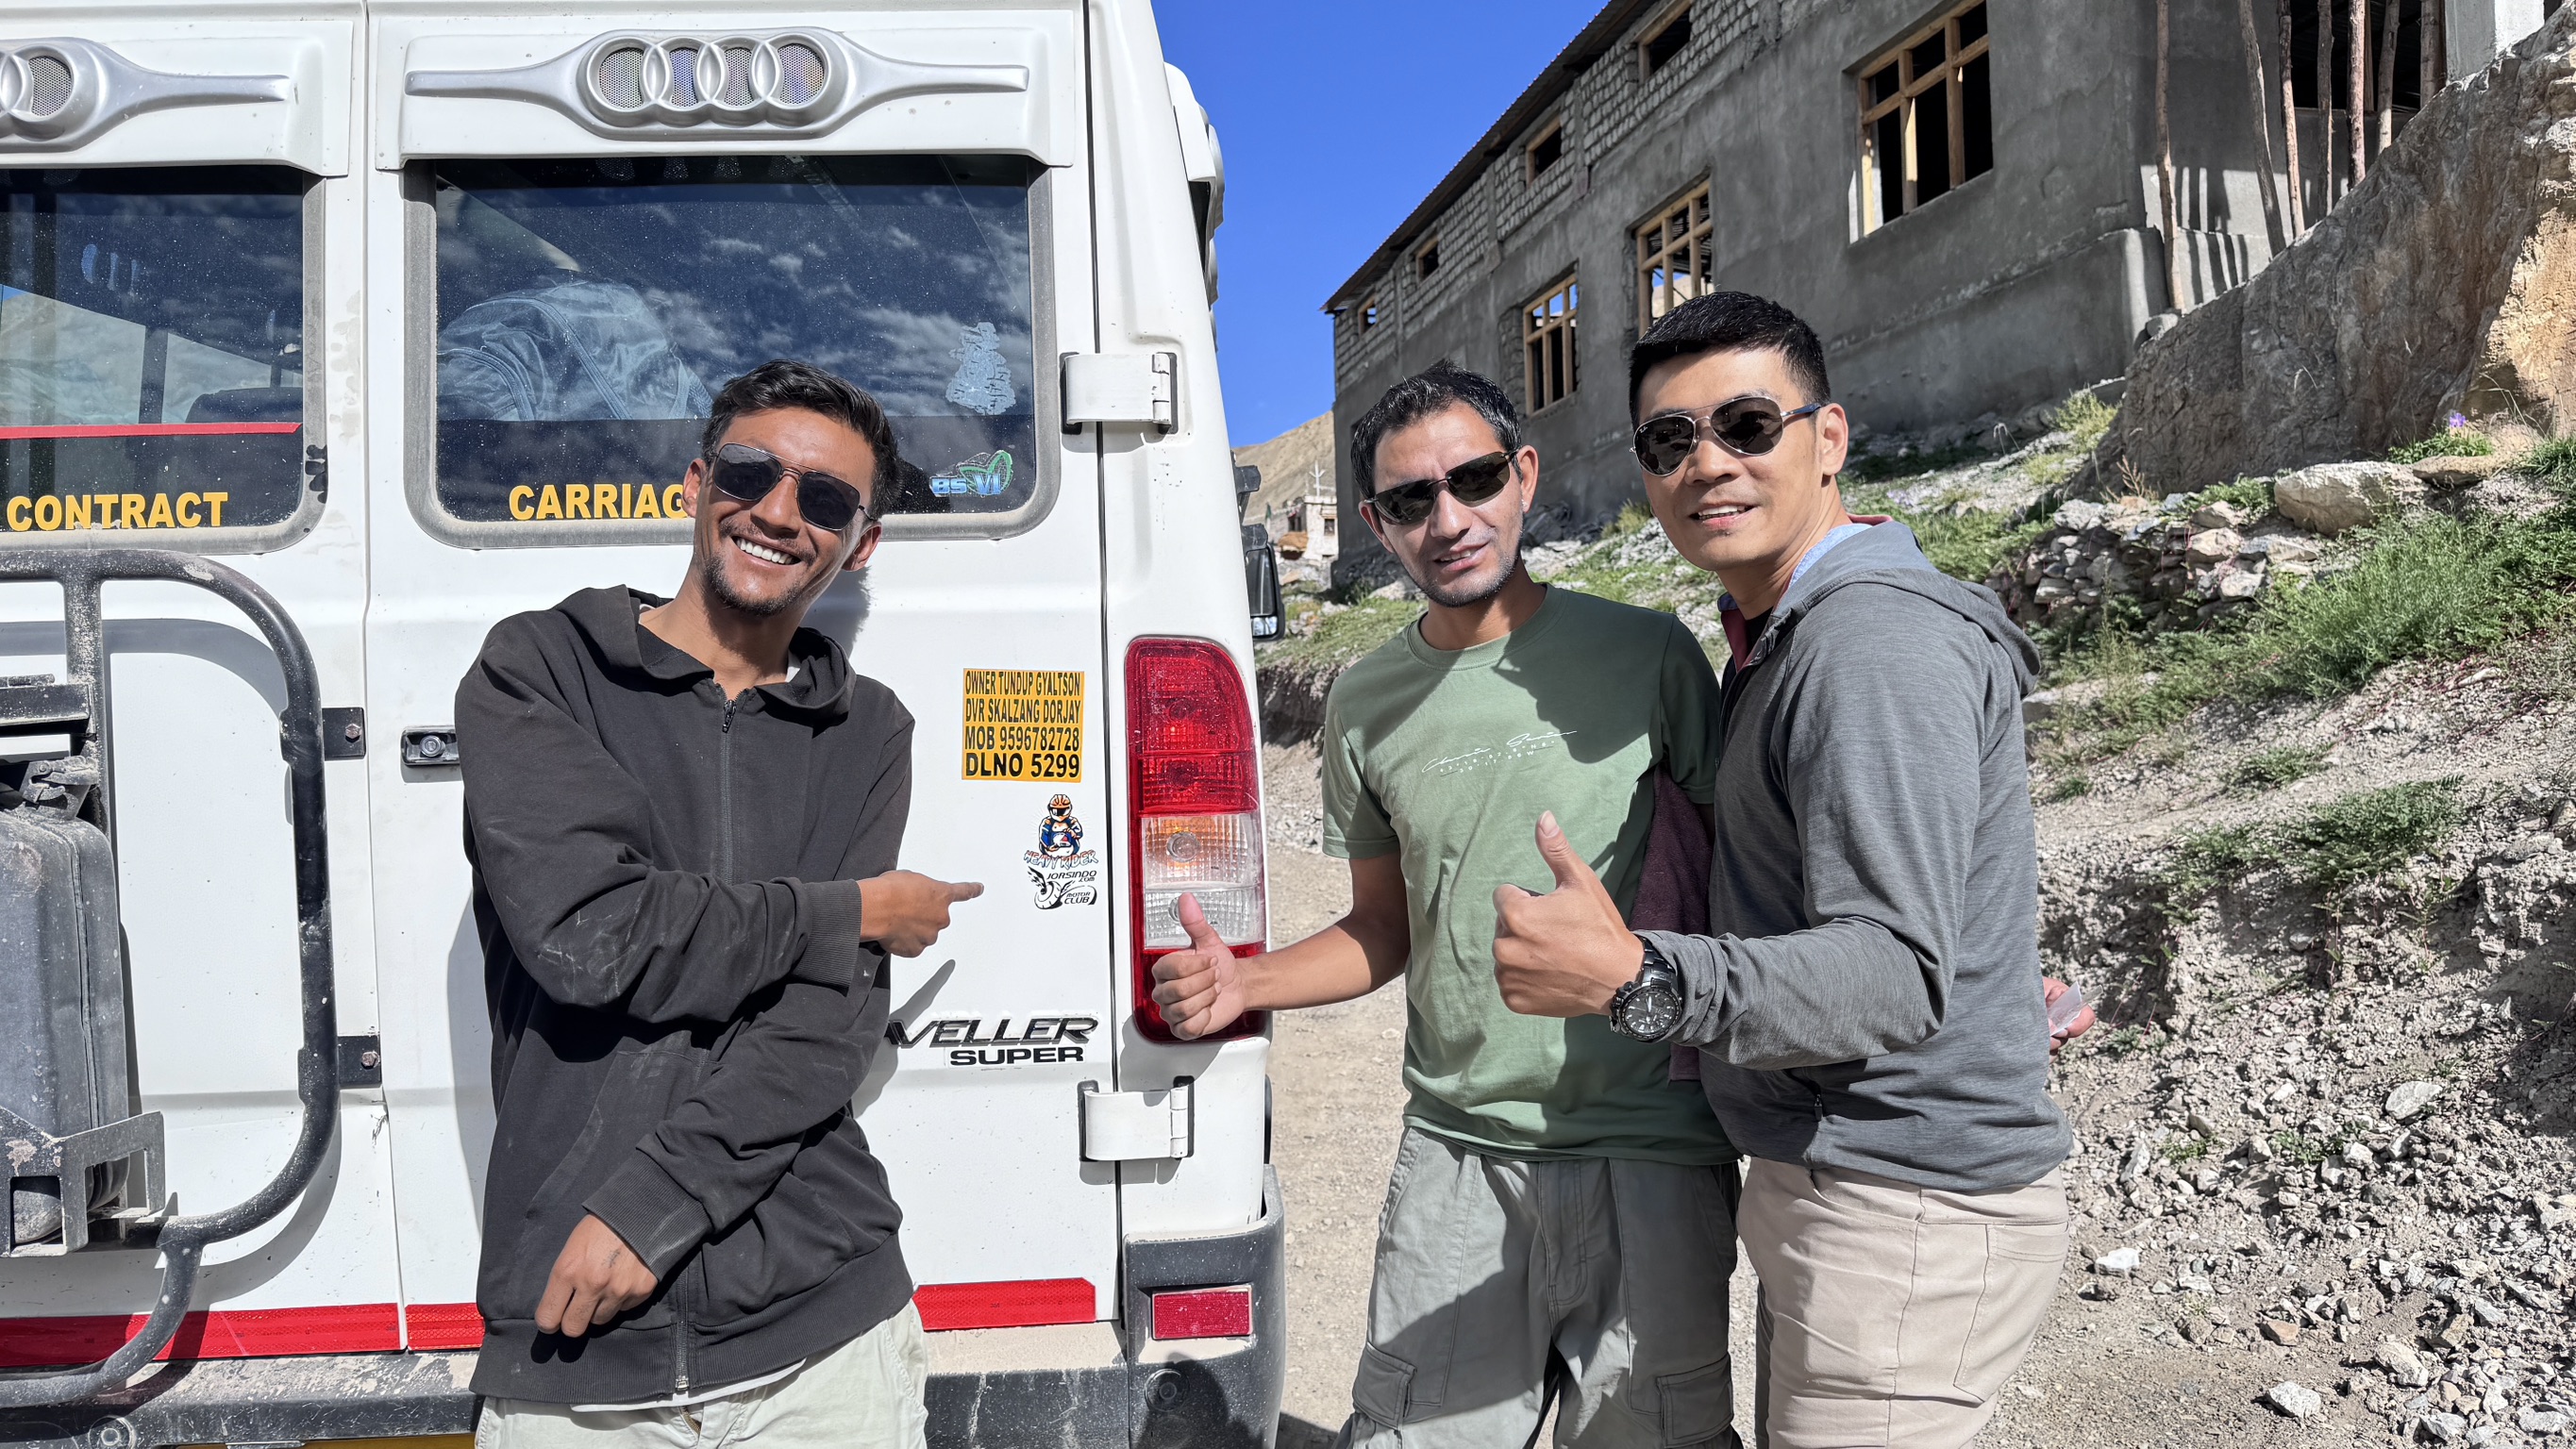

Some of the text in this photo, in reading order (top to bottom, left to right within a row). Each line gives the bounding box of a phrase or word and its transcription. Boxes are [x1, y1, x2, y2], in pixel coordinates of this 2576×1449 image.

[931, 478, 967, 494] BS
[7, 491, 228, 531] CONTRACT
[510, 483, 689, 520] CARRIAG
[965, 671, 1080, 696] OWNER TUNDUP GYALTSON
[965, 698, 1081, 724] DVR SKALZANG DORJAY
[964, 725, 1079, 752] MOB 9596782728
[965, 752, 1080, 778] DLNO 5299
[1064, 896, 1090, 905] CLUB
[950, 1046, 1084, 1066] SUPER
